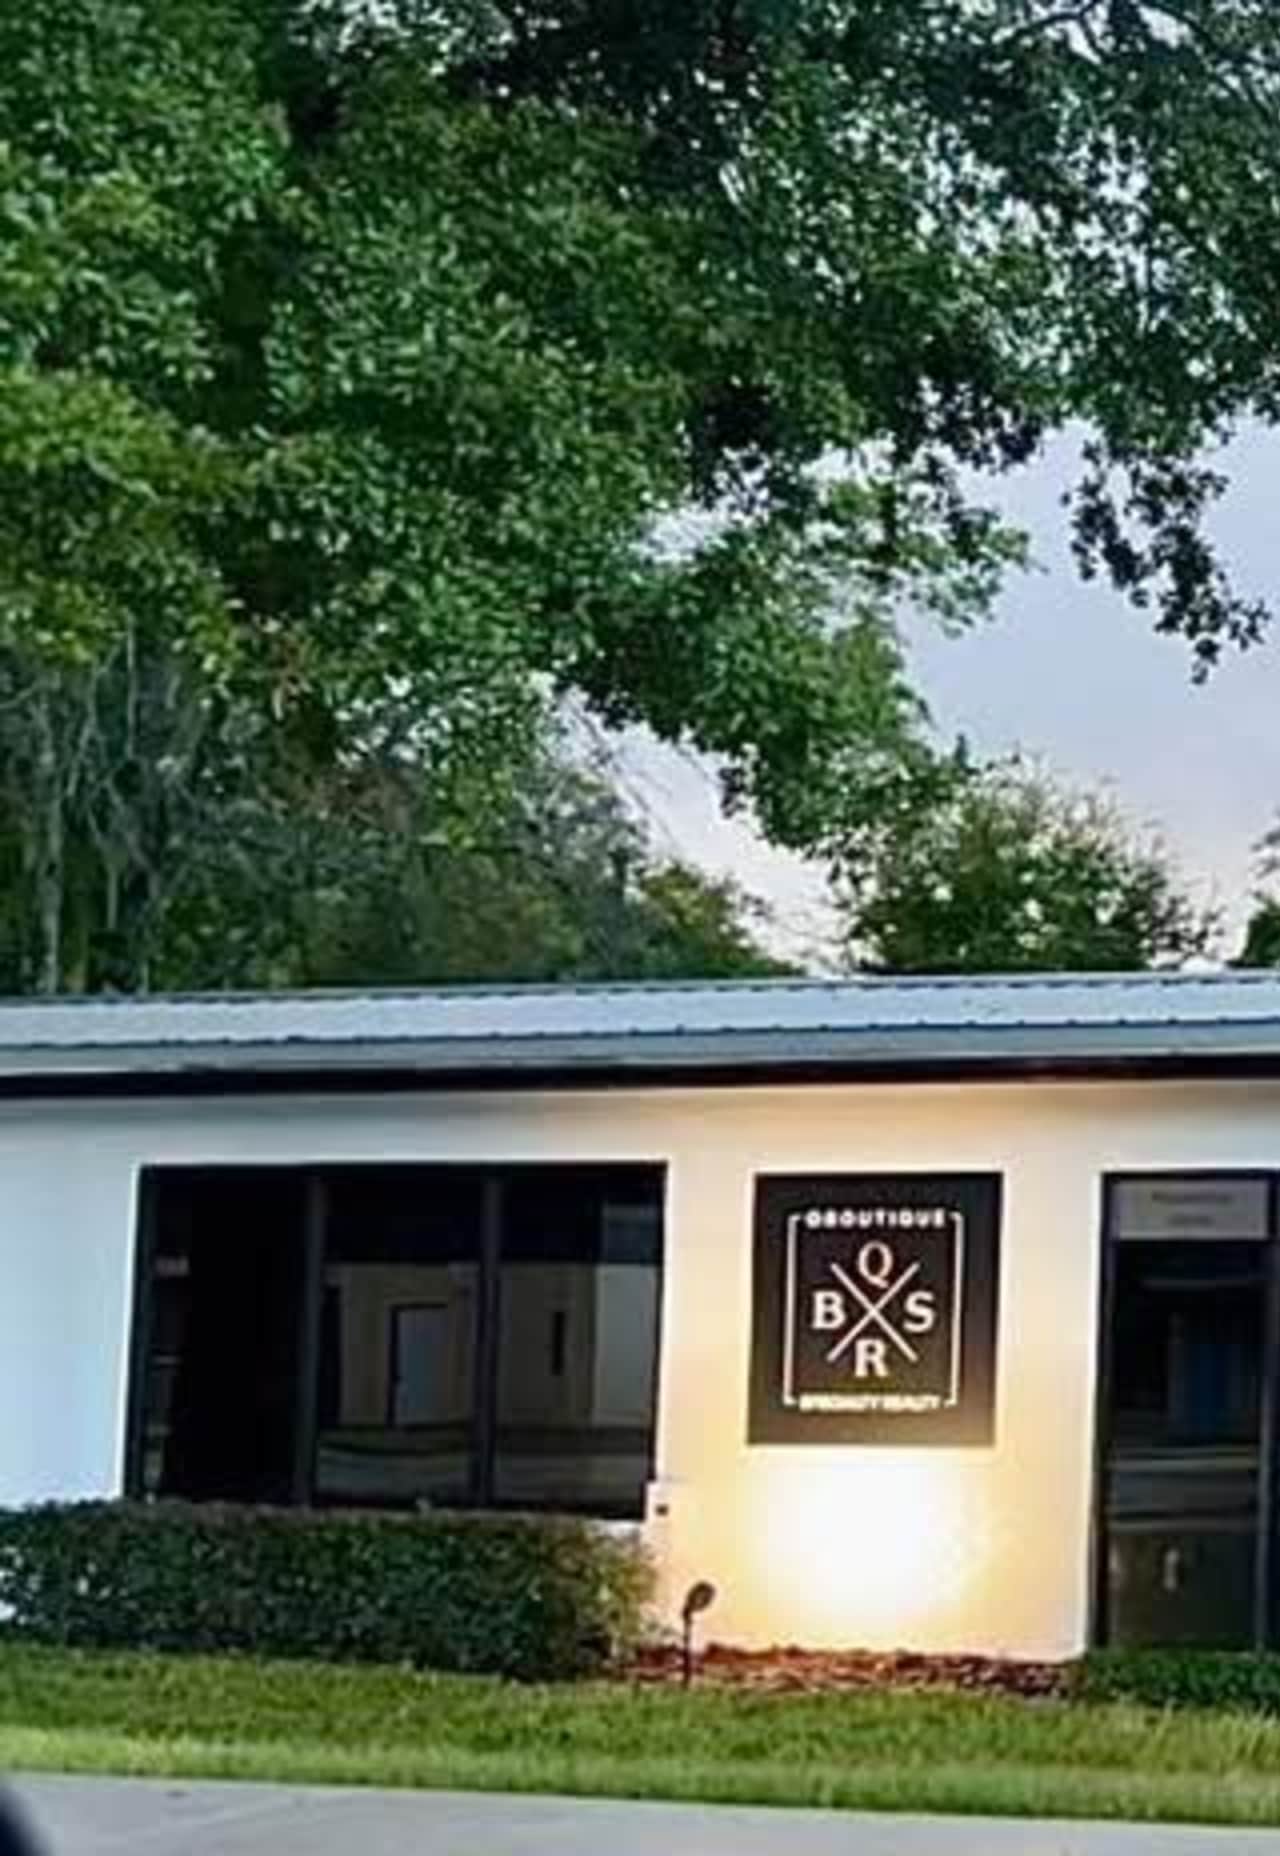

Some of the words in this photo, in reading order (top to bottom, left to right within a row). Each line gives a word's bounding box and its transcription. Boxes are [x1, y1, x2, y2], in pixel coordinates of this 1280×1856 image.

[857, 1240, 893, 1288] Q
[811, 1290, 846, 1330] B
[903, 1290, 935, 1333] S
[854, 1338, 888, 1378] R
